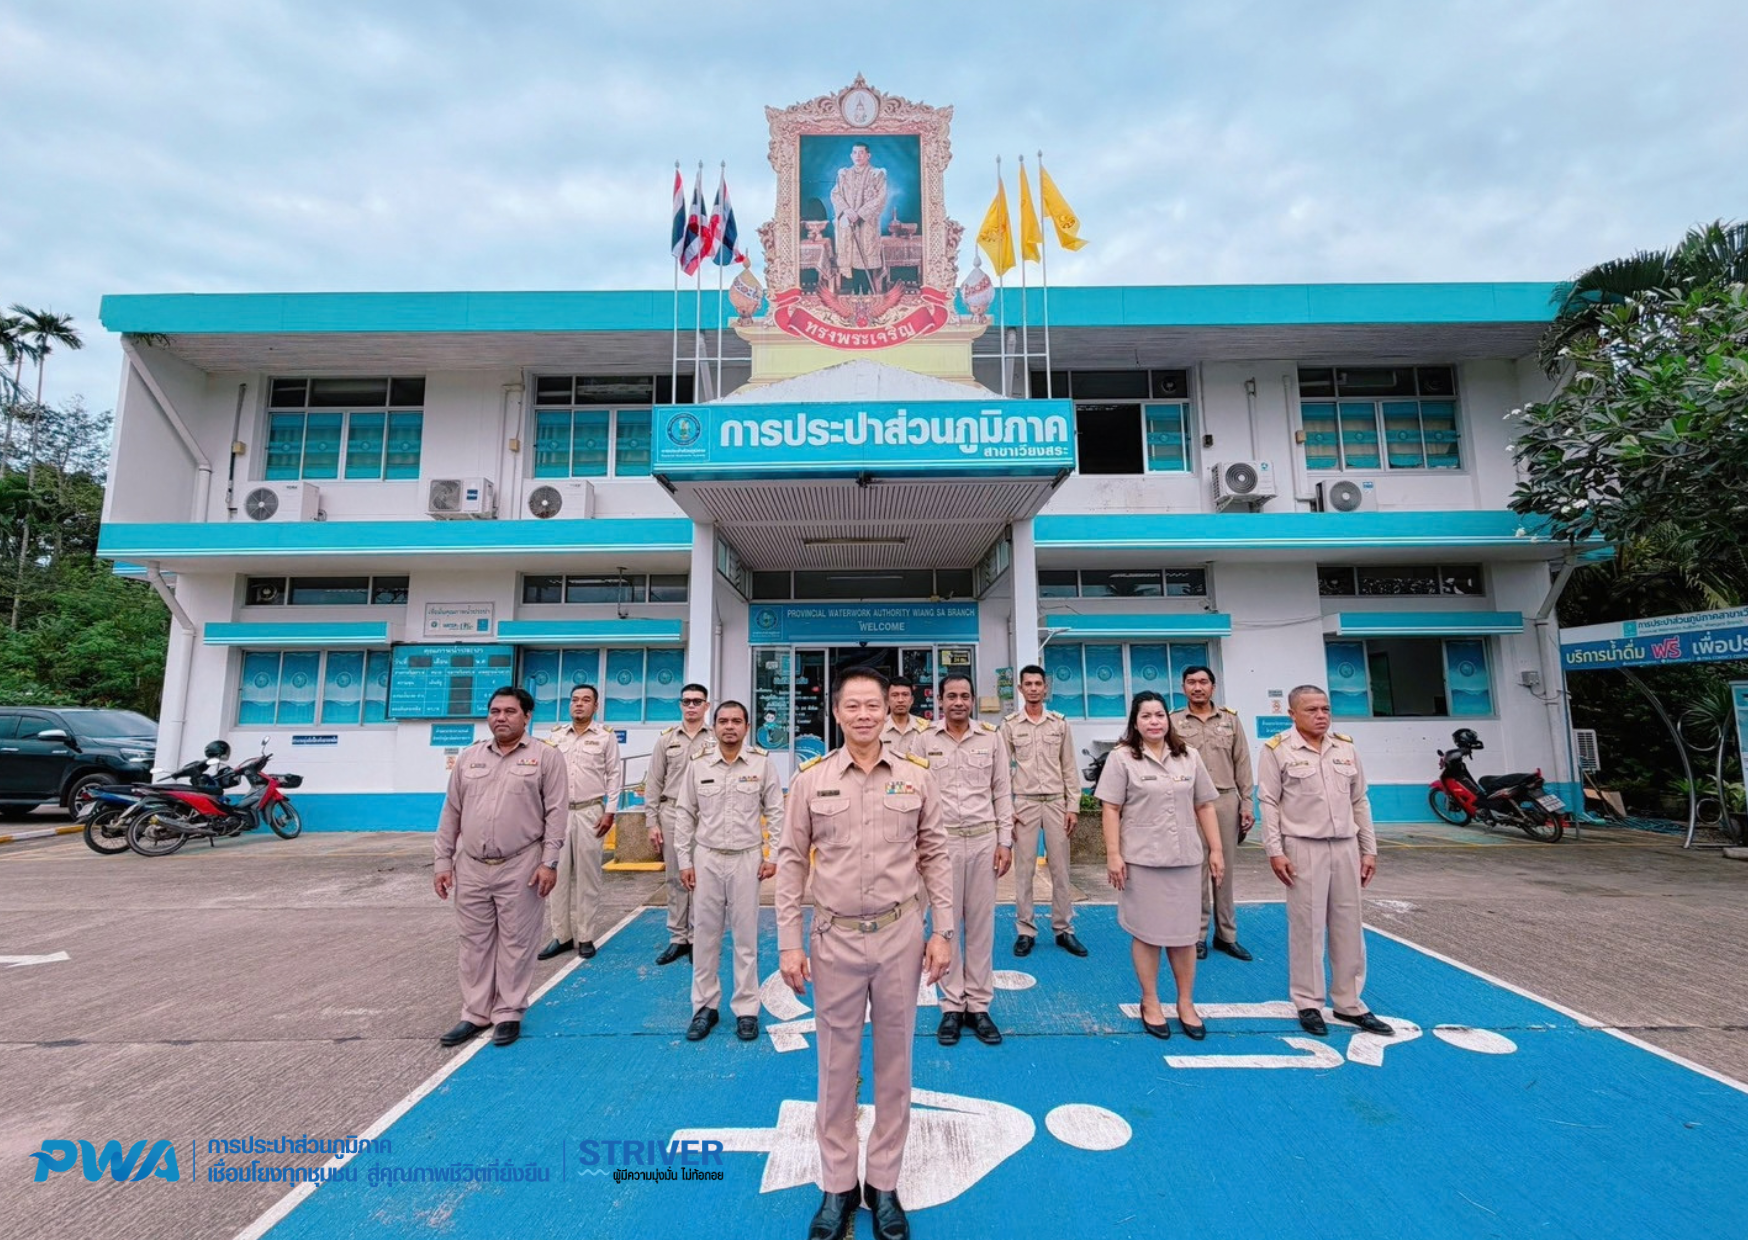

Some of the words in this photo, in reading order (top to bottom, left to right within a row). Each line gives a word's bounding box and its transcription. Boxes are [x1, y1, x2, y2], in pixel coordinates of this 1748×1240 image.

[805, 320, 916, 345] ทรงพระเจริญ
[720, 409, 1068, 453] การประปาส่วนภูมิภาค
[984, 444, 1068, 457] สาขาเวียงสระ
[787, 609, 826, 618] PROVINCIAL
[828, 609, 871, 617] WATERWORK
[873, 608, 910, 617] AUTHORITY
[912, 608, 934, 617] WIANG
[936, 608, 945, 617] SA
[947, 608, 975, 617] BRANCH
[859, 621, 905, 631] WELCOME
[1566, 639, 1645, 664] บริการน้ำดื่ม
[1651, 635, 1682, 659] ฟรี
